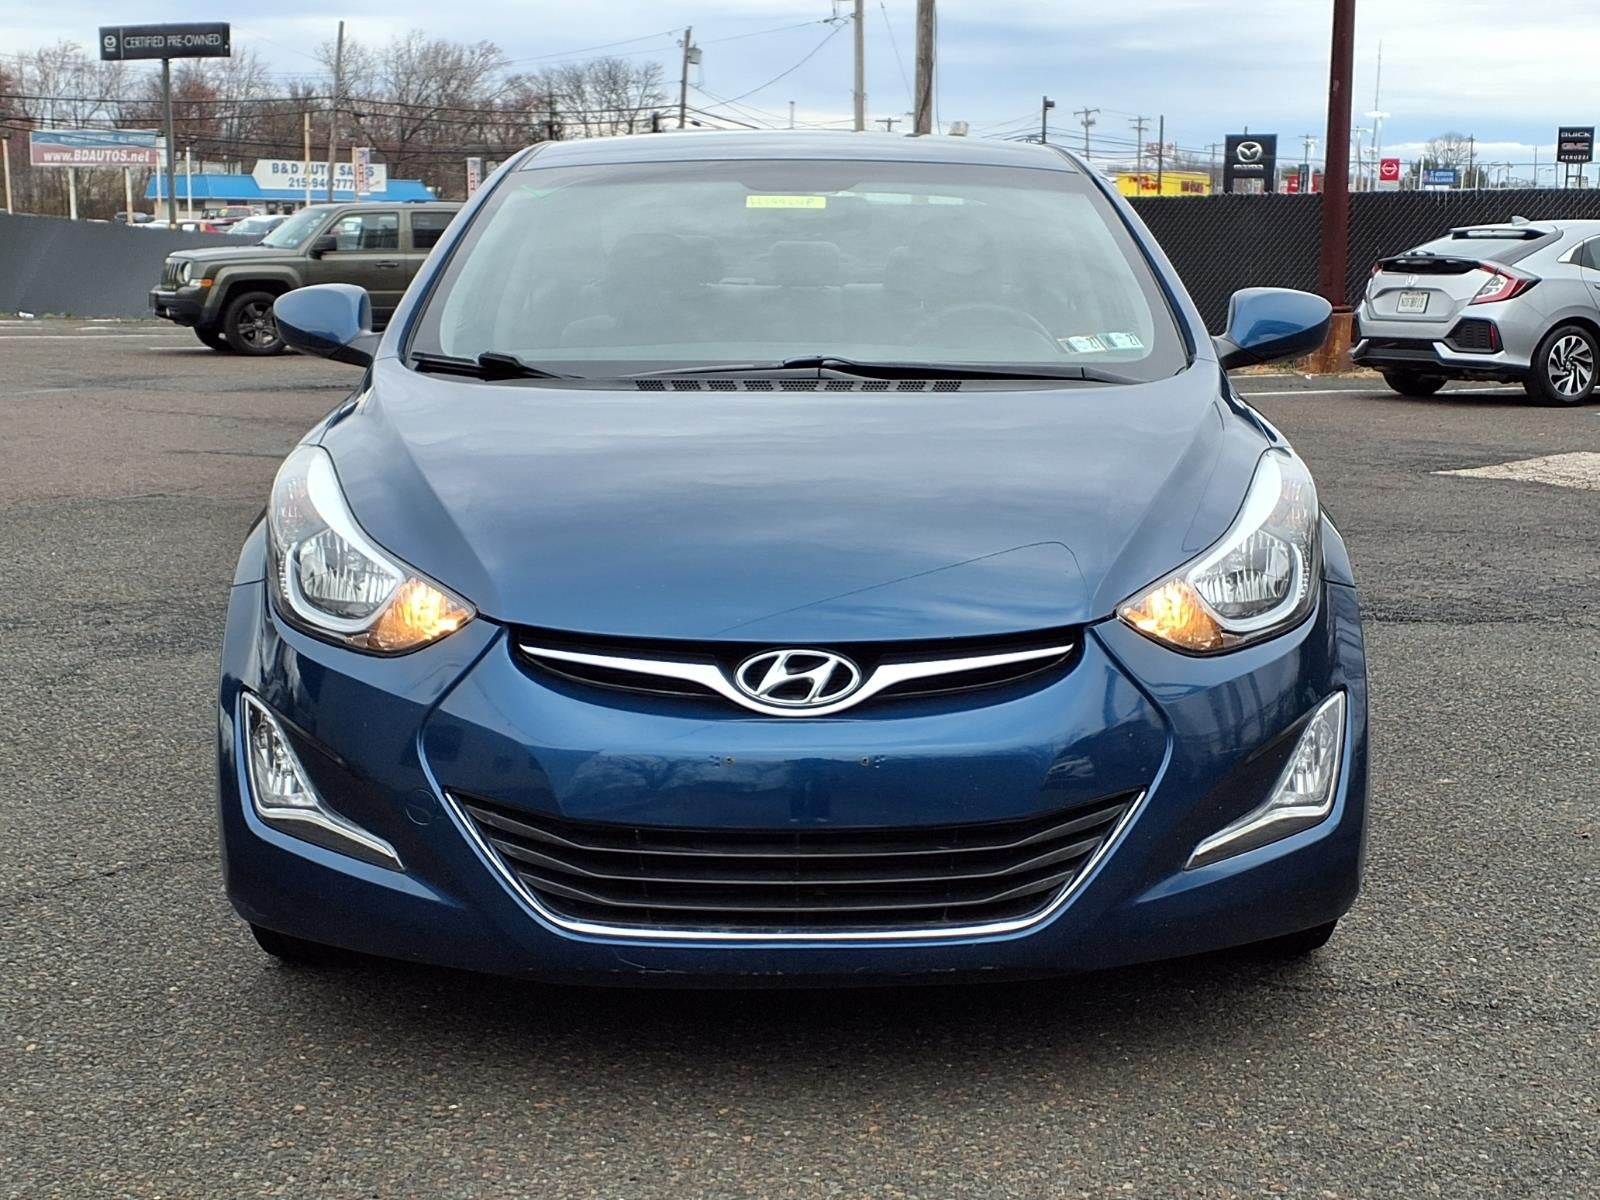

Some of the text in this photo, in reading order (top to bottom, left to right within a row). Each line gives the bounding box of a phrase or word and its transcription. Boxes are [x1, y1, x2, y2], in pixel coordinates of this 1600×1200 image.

[124, 33, 221, 49] CERTIFIED PRE-OWNED
[43, 149, 150, 163] www.BDAUTOS.net
[271, 162, 299, 175] B&D
[339, 164, 375, 177] SAS
